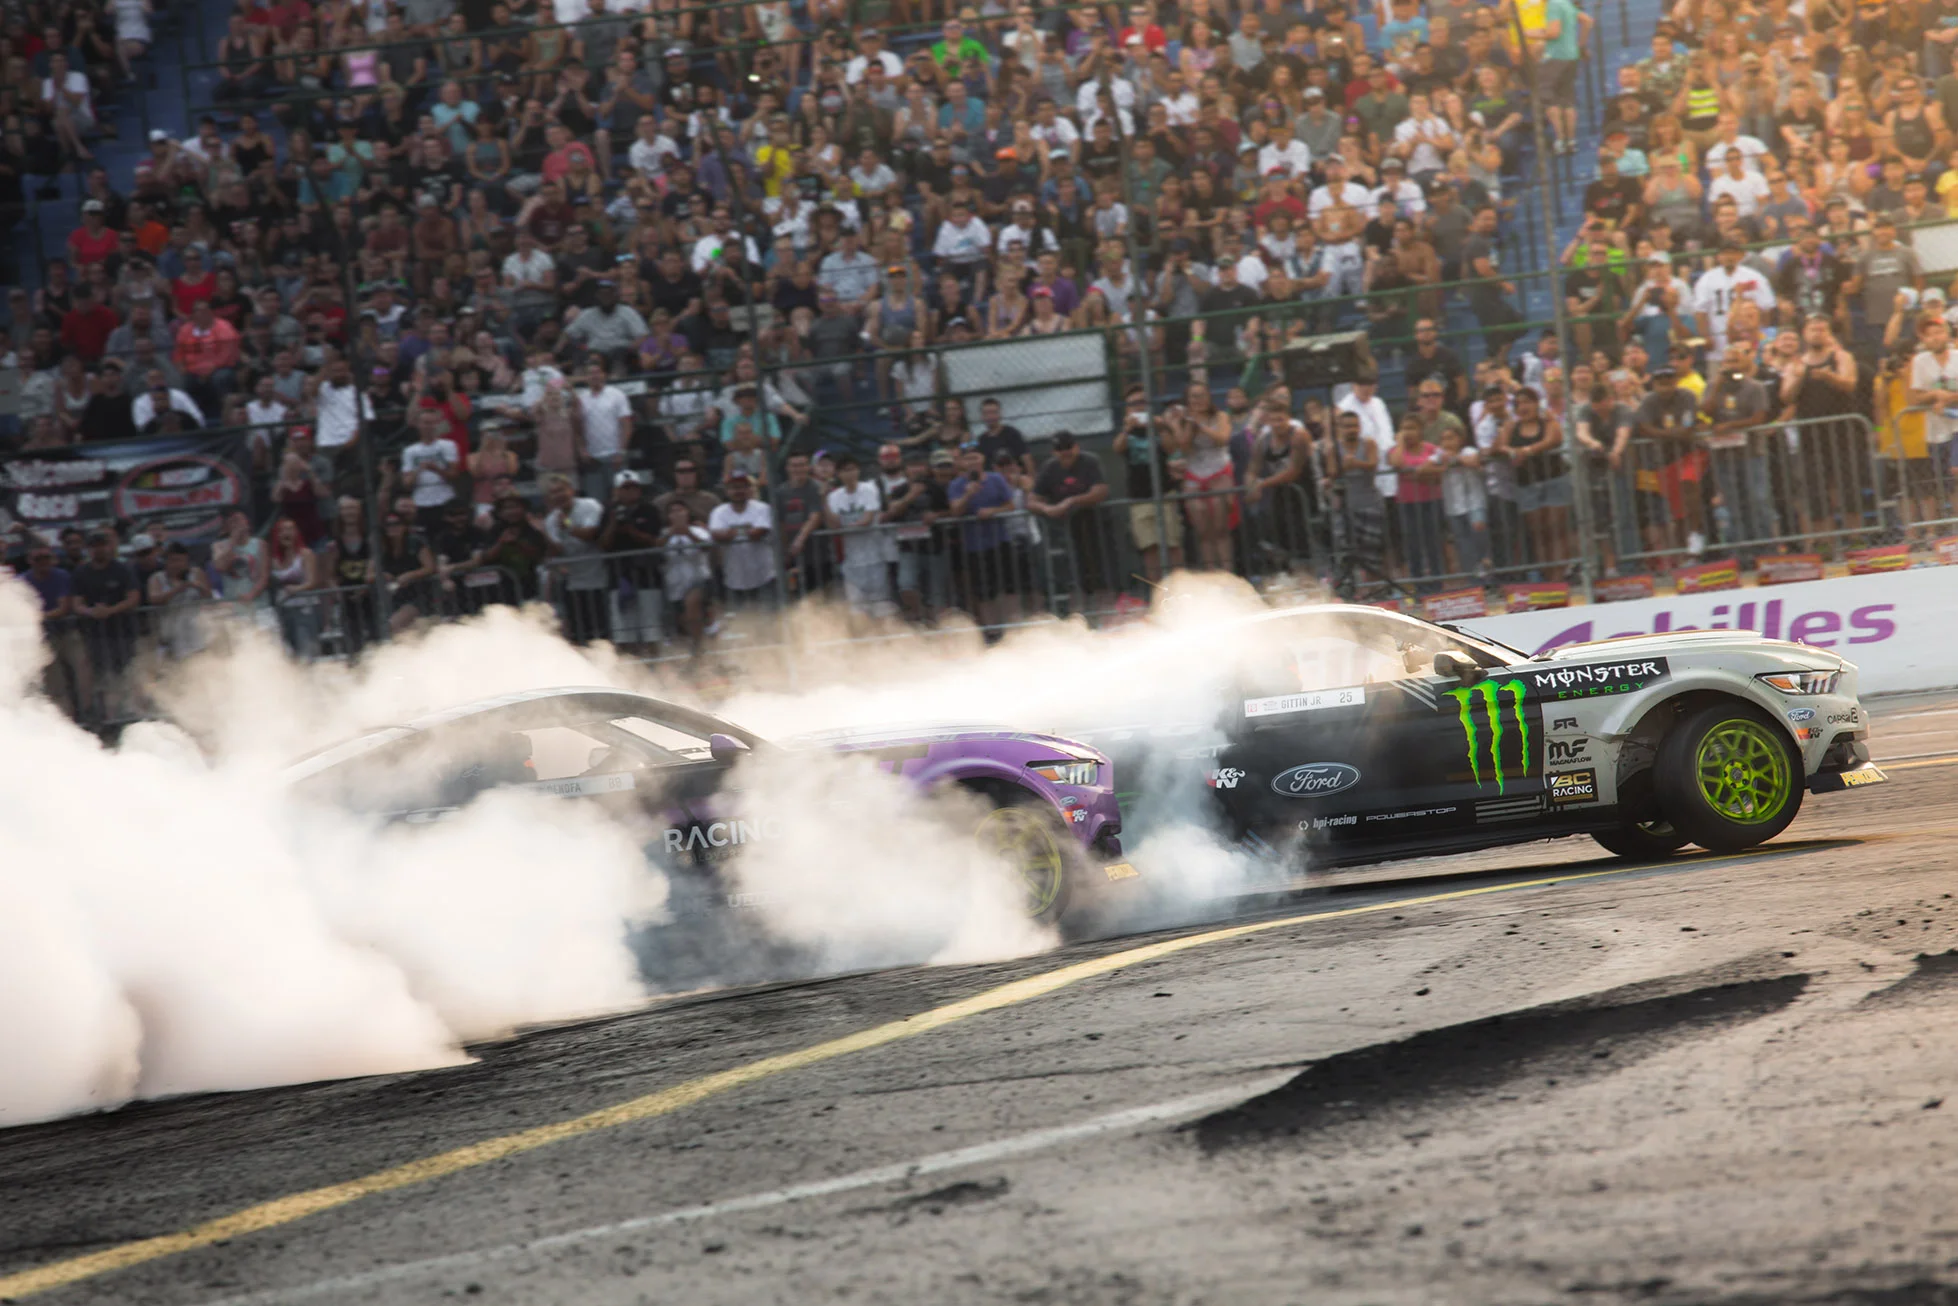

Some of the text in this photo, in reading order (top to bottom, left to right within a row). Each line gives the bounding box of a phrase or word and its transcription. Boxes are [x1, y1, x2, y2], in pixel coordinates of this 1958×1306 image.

[1531, 599, 1897, 656] Ailles
[1534, 661, 1662, 688] MONSTER
[1558, 682, 1644, 699] ENERGY
[1281, 697, 1308, 709] GITTIN
[1311, 696, 1322, 706] JR
[1339, 692, 1353, 703] 25
[1553, 717, 1579, 731] RTR
[1549, 756, 1592, 766] MAGNAFLOW
[1290, 768, 1342, 792] Ford
[1553, 785, 1593, 797] RACING
[1312, 814, 1358, 830] hpi-racing
[1366, 806, 1457, 822] POWERSTOP
[663, 816, 782, 853] RACING
